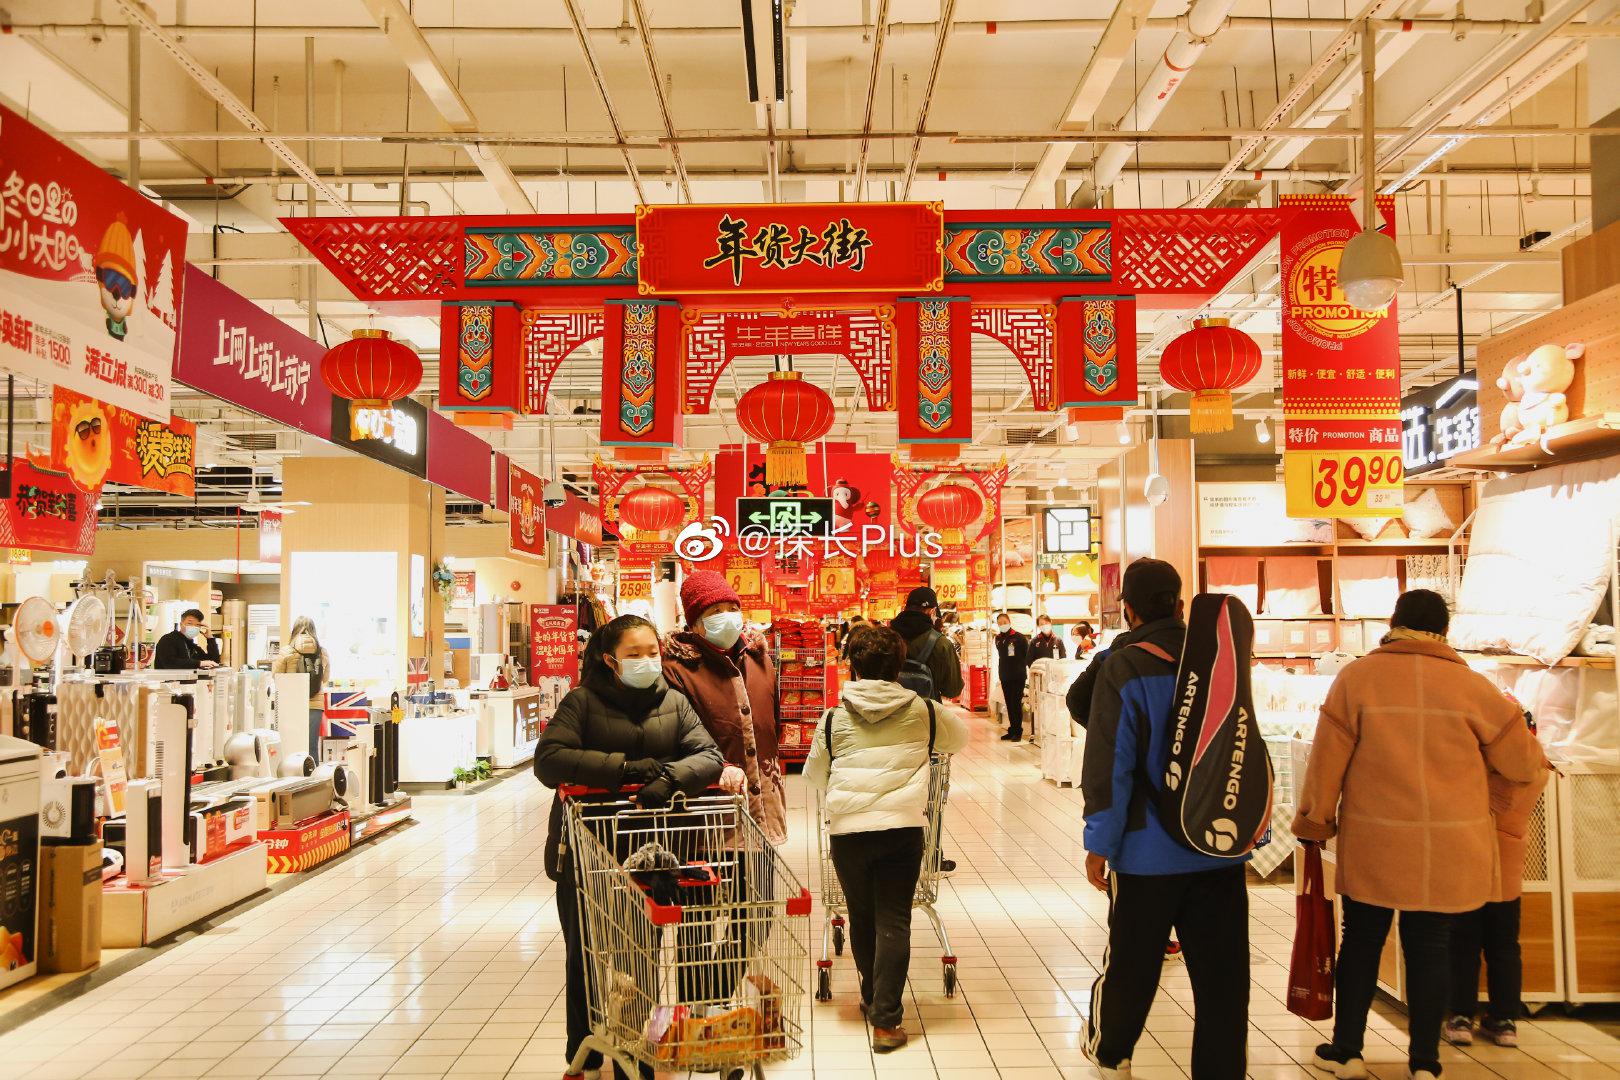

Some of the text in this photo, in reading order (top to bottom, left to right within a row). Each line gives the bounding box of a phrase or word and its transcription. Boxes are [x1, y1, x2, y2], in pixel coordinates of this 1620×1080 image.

[704, 213, 872, 287] 年货大街
[1302, 265, 1346, 301] 特
[1291, 306, 1389, 319] PROMOTION
[49, 340, 71, 365] 1500
[737, 324, 842, 347] 牛年吉祥
[85, 345, 128, 389] 满立减
[213, 318, 313, 406] 上网上街上苏宁
[1288, 428, 1319, 443] 特价
[1368, 428, 1399, 443] 商品
[1172, 671, 1199, 755] ARTENGO
[1223, 706, 1248, 811] ARTENGO
